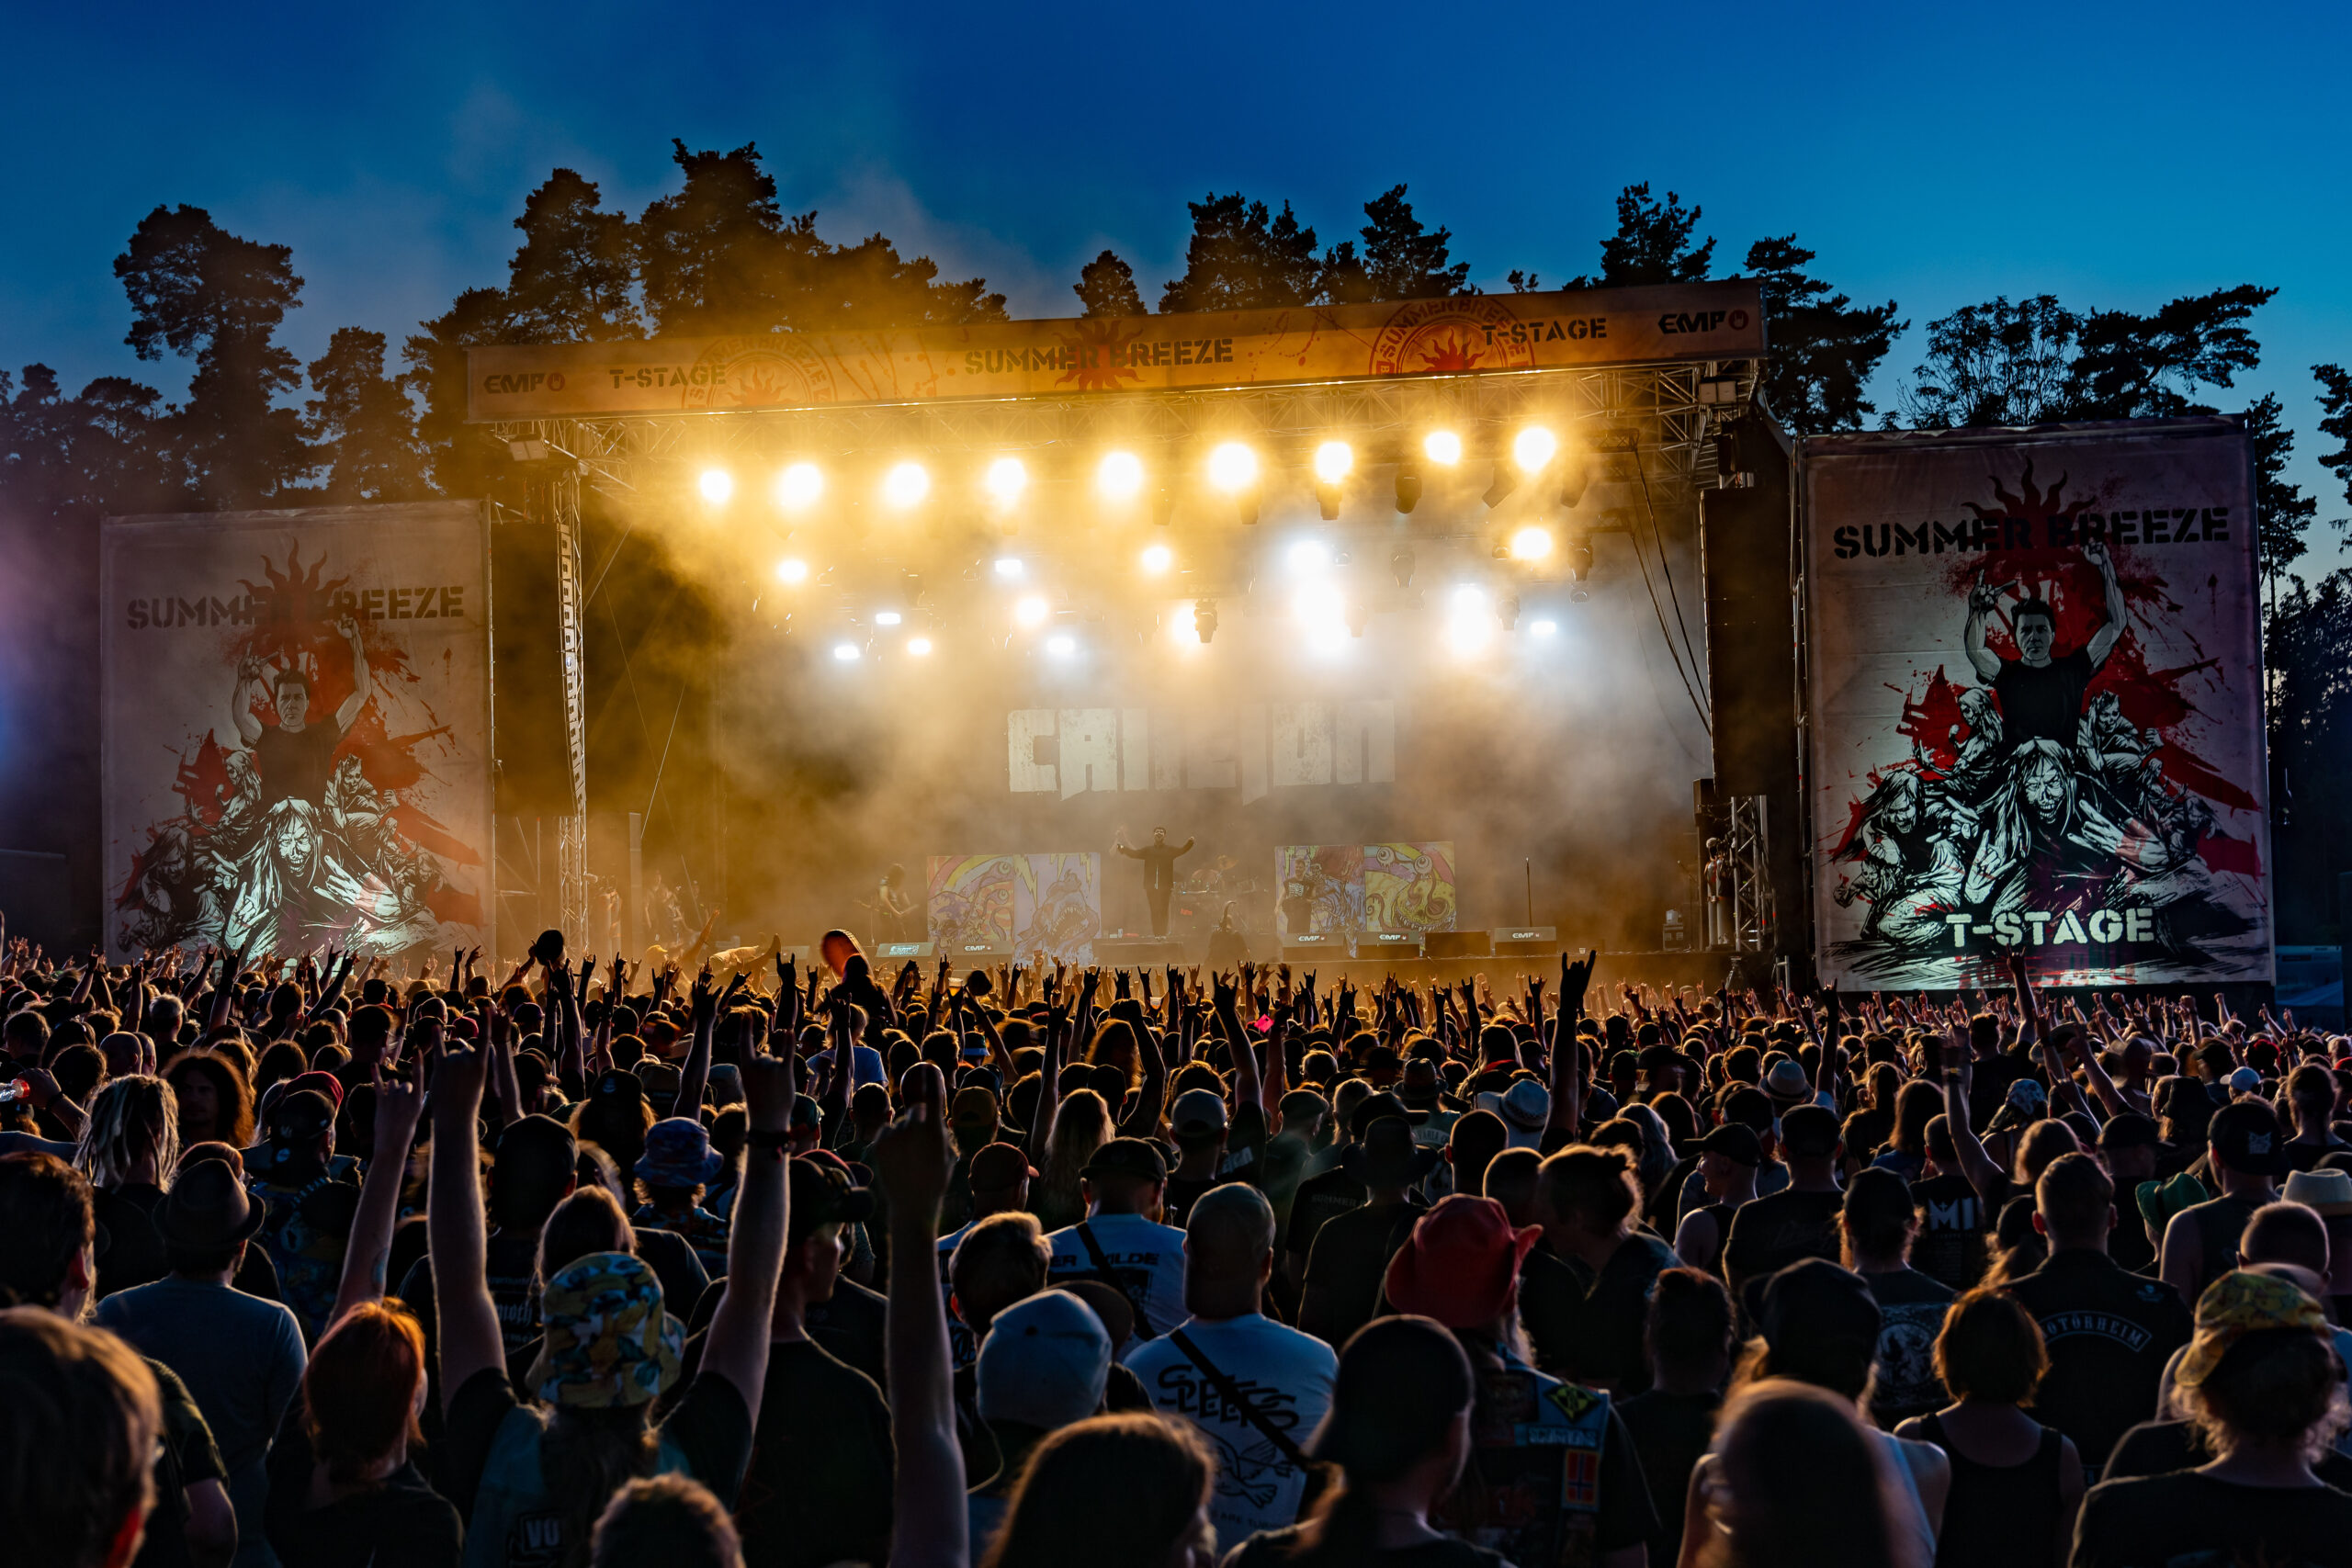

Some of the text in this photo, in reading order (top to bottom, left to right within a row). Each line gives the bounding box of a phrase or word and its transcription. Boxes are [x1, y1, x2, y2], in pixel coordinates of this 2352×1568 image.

[1481, 317, 1607, 346] T-STAGE
[1657, 310, 1727, 335] EMP
[965, 338, 1234, 376] SUMMER BREEZE
[483, 372, 547, 394] EMP
[609, 364, 727, 390] T-STAGE
[1833, 507, 2231, 559] SUMMER BREEZE
[1945, 907, 2155, 948] T-STAGE
